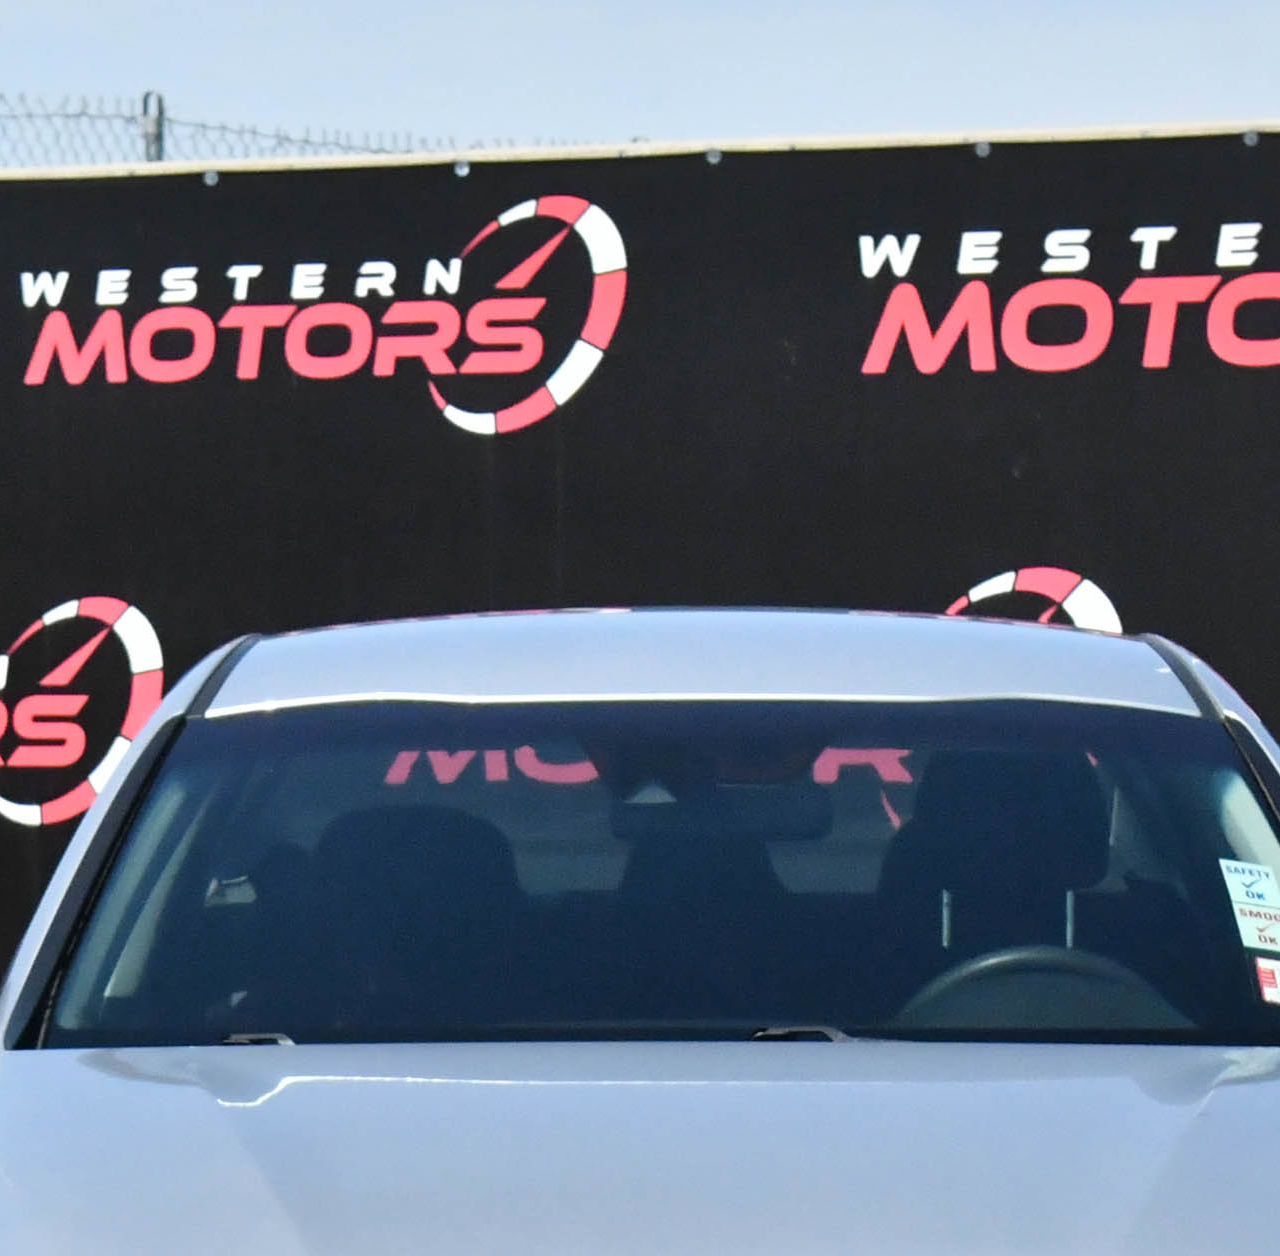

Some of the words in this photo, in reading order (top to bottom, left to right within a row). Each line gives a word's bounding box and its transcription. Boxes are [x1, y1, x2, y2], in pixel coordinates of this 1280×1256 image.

[20, 257, 463, 308] WESTERN
[23, 295, 547, 387] MOTORS
[1225, 865, 1270, 879] SAFETY
[1246, 890, 1266, 900] OK
[1259, 934, 1278, 945] OK
